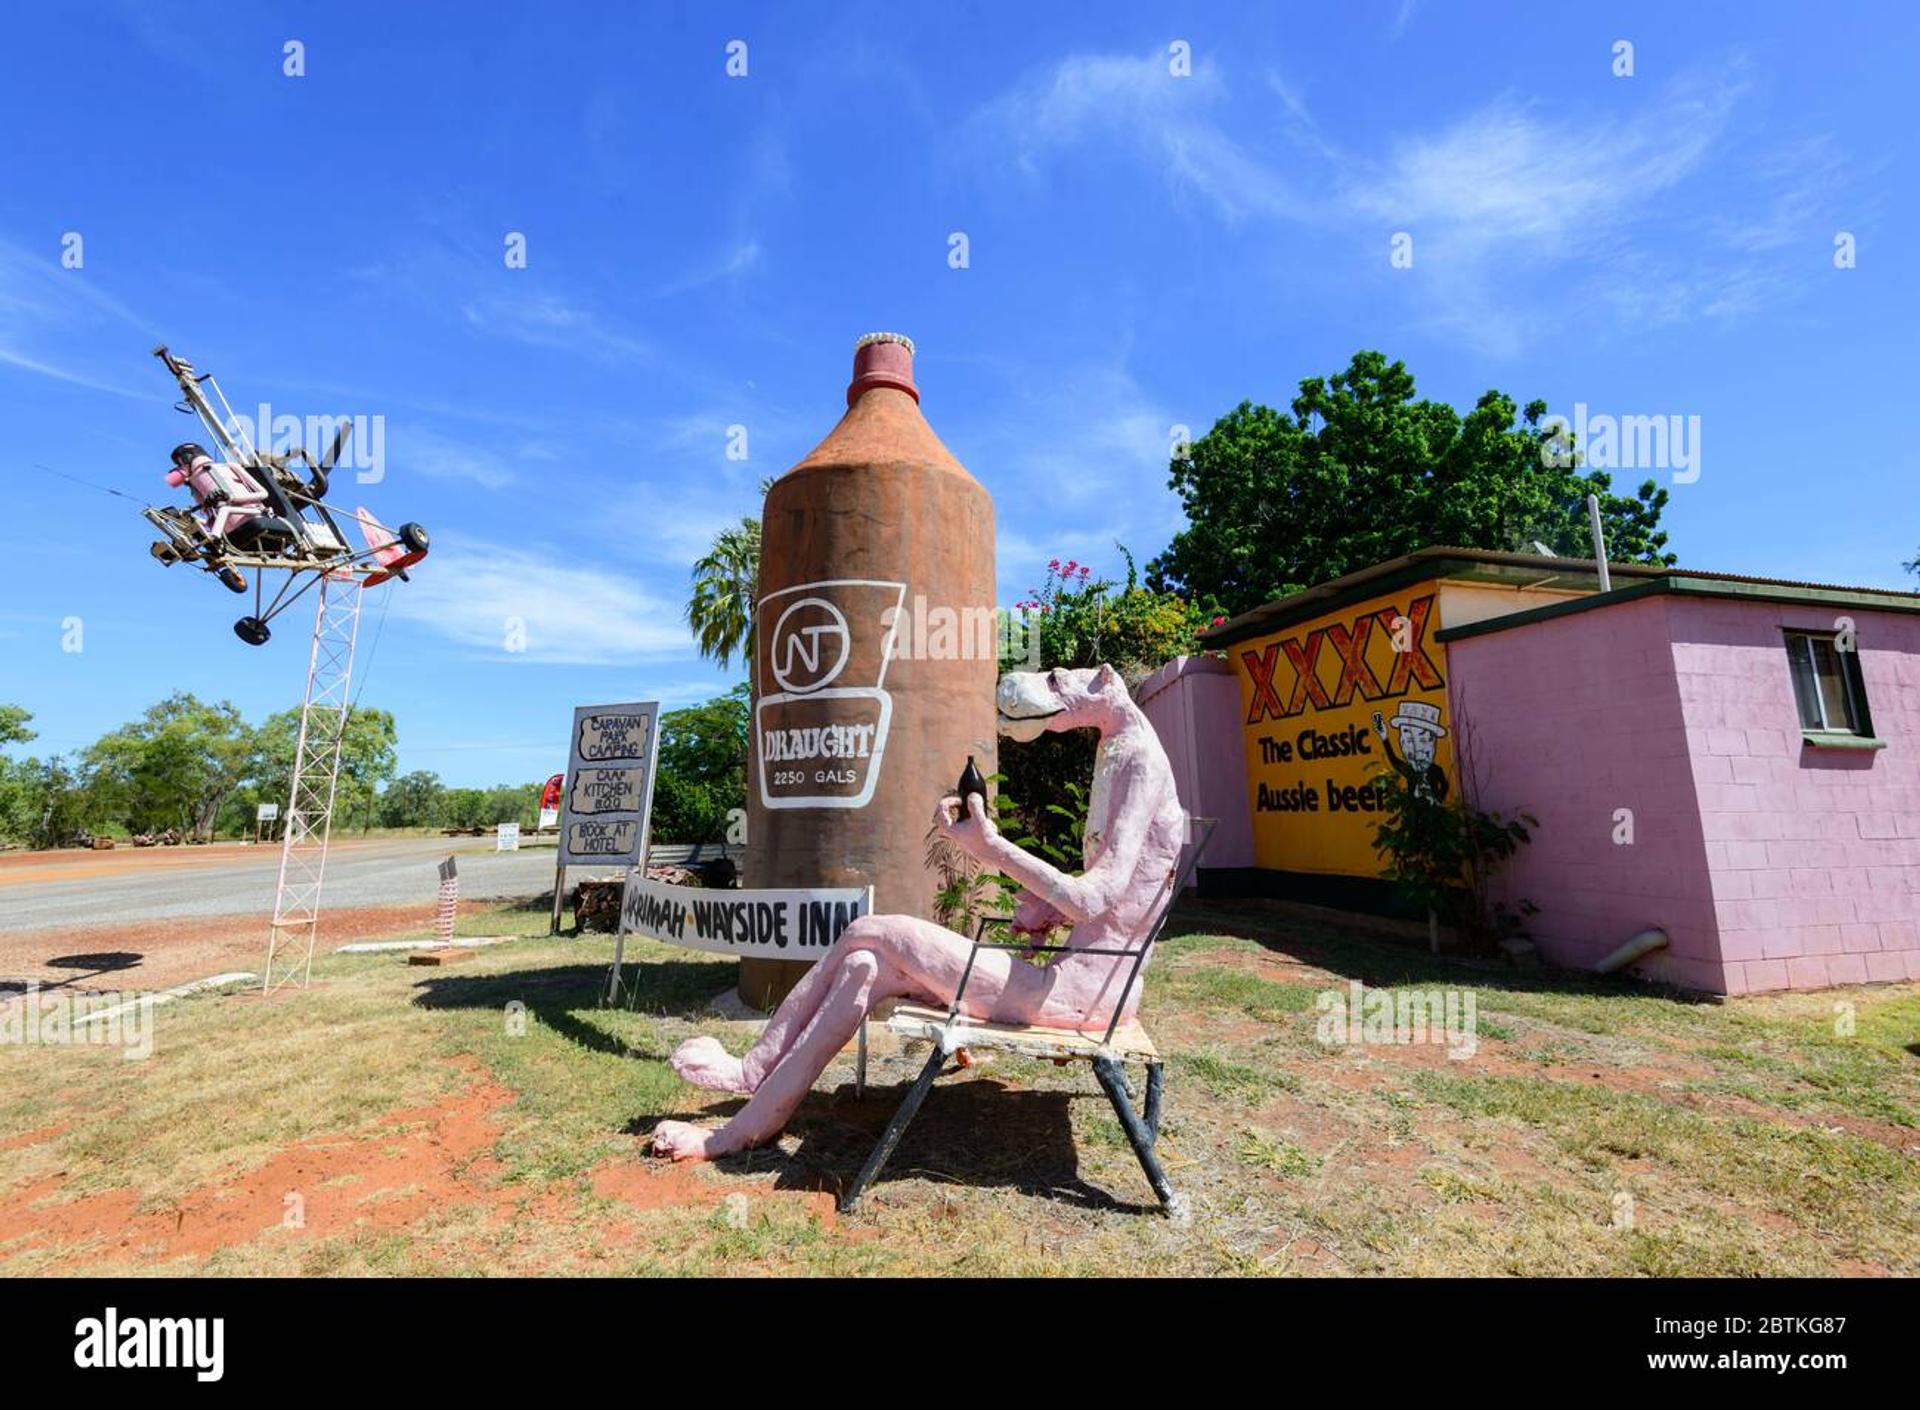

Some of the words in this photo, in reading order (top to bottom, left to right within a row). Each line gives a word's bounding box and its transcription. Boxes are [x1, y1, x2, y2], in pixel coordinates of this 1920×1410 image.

[777, 624, 843, 673] NT
[1242, 593, 1445, 725] XXXX
[590, 716, 641, 731] CARAVAN
[588, 742, 638, 757] CAMPING
[764, 723, 875, 762] DRAUGHT
[1259, 735, 1292, 765] The
[1296, 723, 1372, 761] Classic
[583, 781, 633, 798] KITCHEN
[774, 770, 805, 786] 2250
[815, 769, 857, 784] GALS
[1257, 780, 1318, 812] Aussie
[579, 823, 608, 838] BOOK
[614, 822, 629, 837] AT
[583, 837, 619, 852] HOTEL
[692, 900, 788, 948] WAYSIDE
[799, 900, 858, 946] INN
